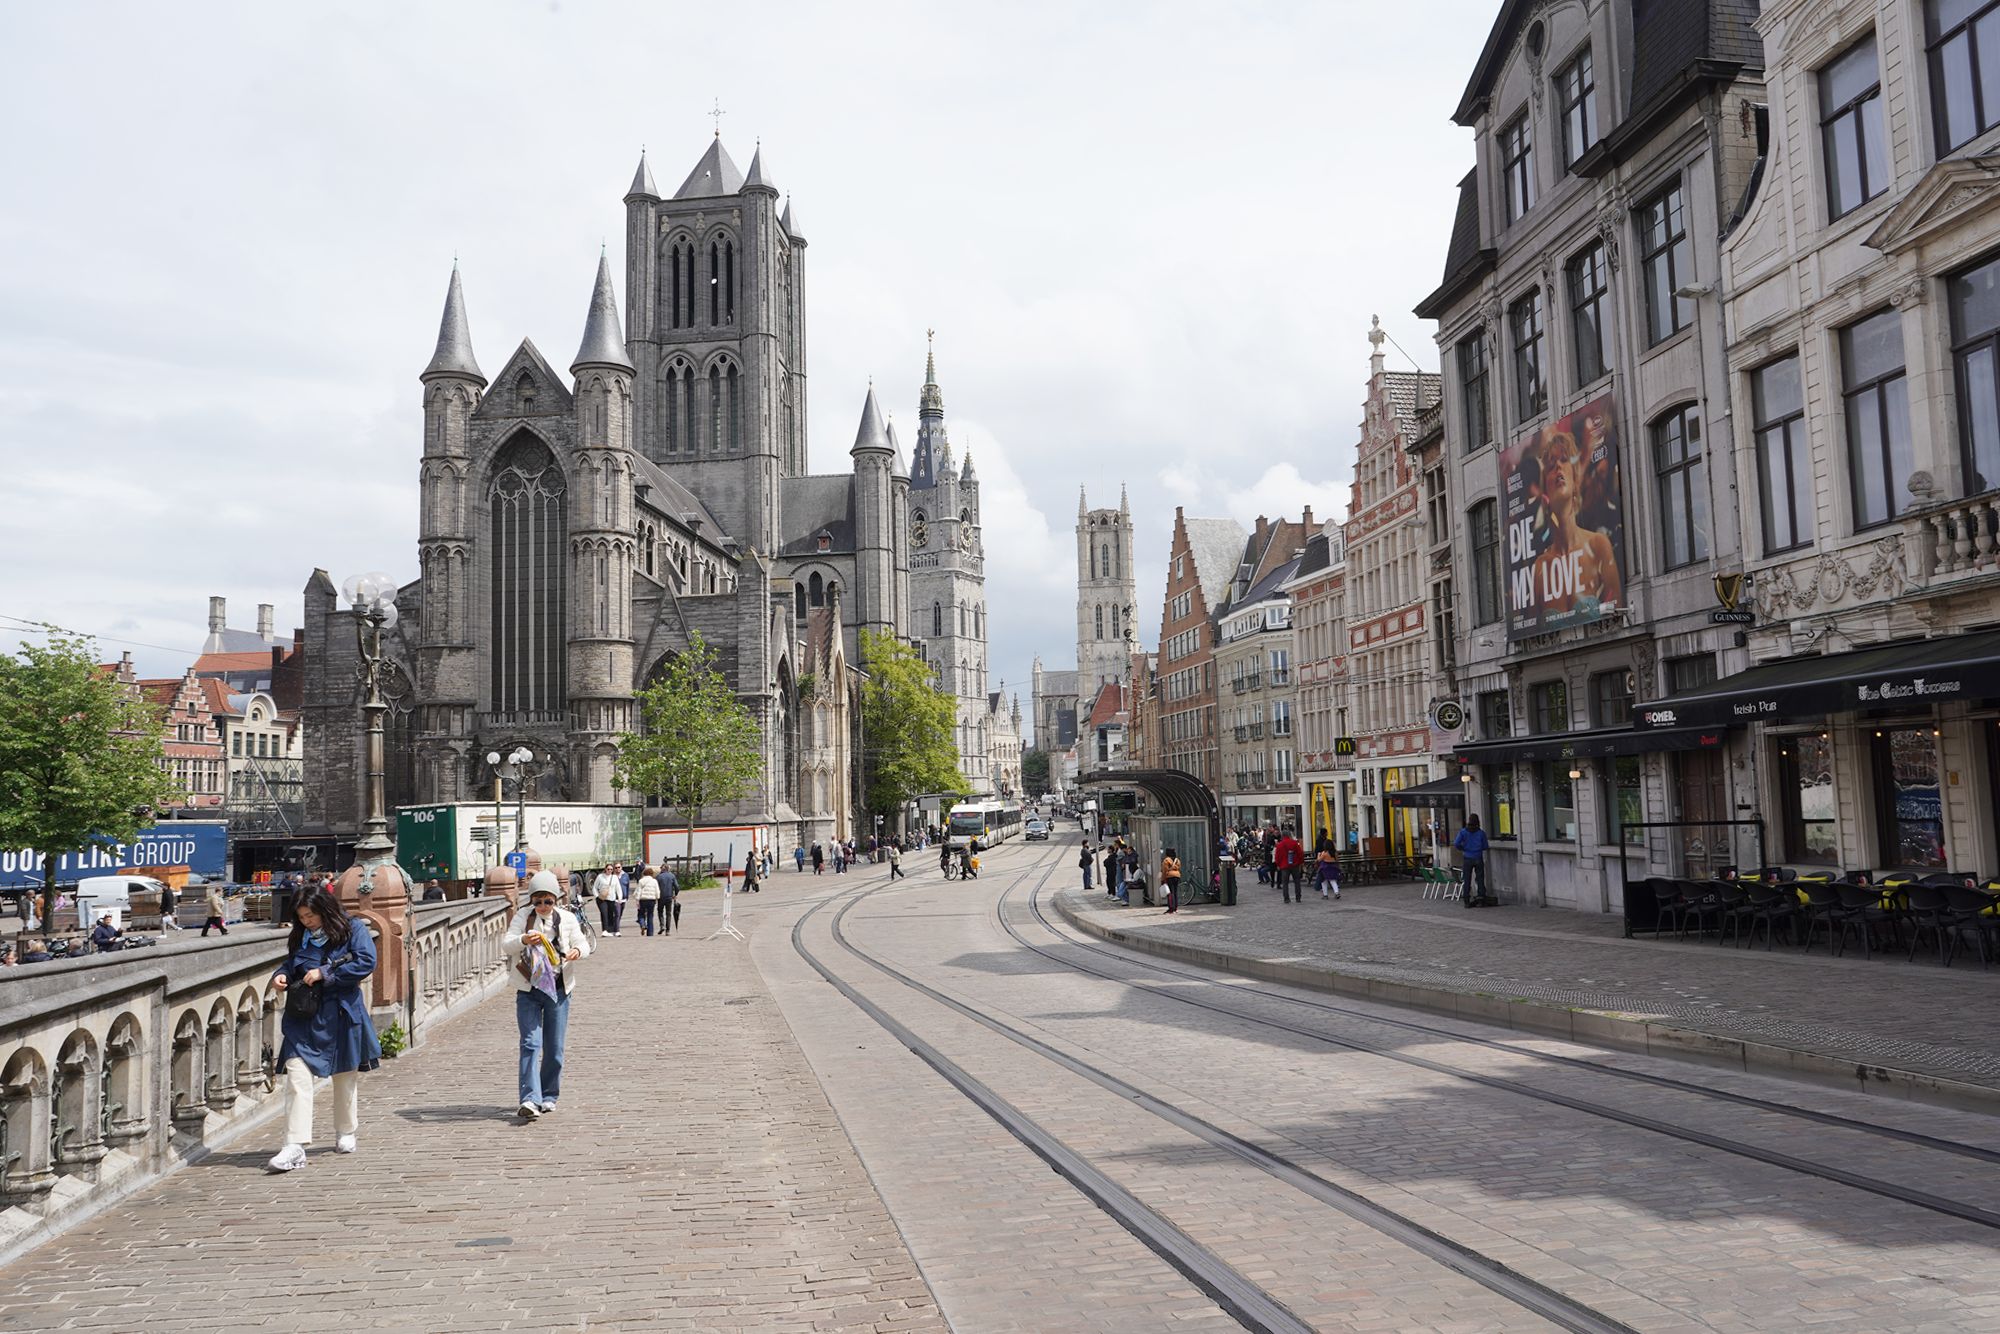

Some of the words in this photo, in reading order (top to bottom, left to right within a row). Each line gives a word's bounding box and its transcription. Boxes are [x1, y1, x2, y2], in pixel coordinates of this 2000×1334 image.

[1509, 515, 1536, 564] DIE
[1512, 563, 1536, 611] MY
[1542, 550, 1585, 602] LOVE
[1715, 612, 1751, 622] GUINNESS
[1858, 685, 1880, 700] The
[1880, 682, 1913, 699] Celtic
[413, 811, 435, 823] 106
[78, 843, 126, 869] LIKE
[133, 841, 196, 866] GROUP
[512, 856, 522, 867] P
